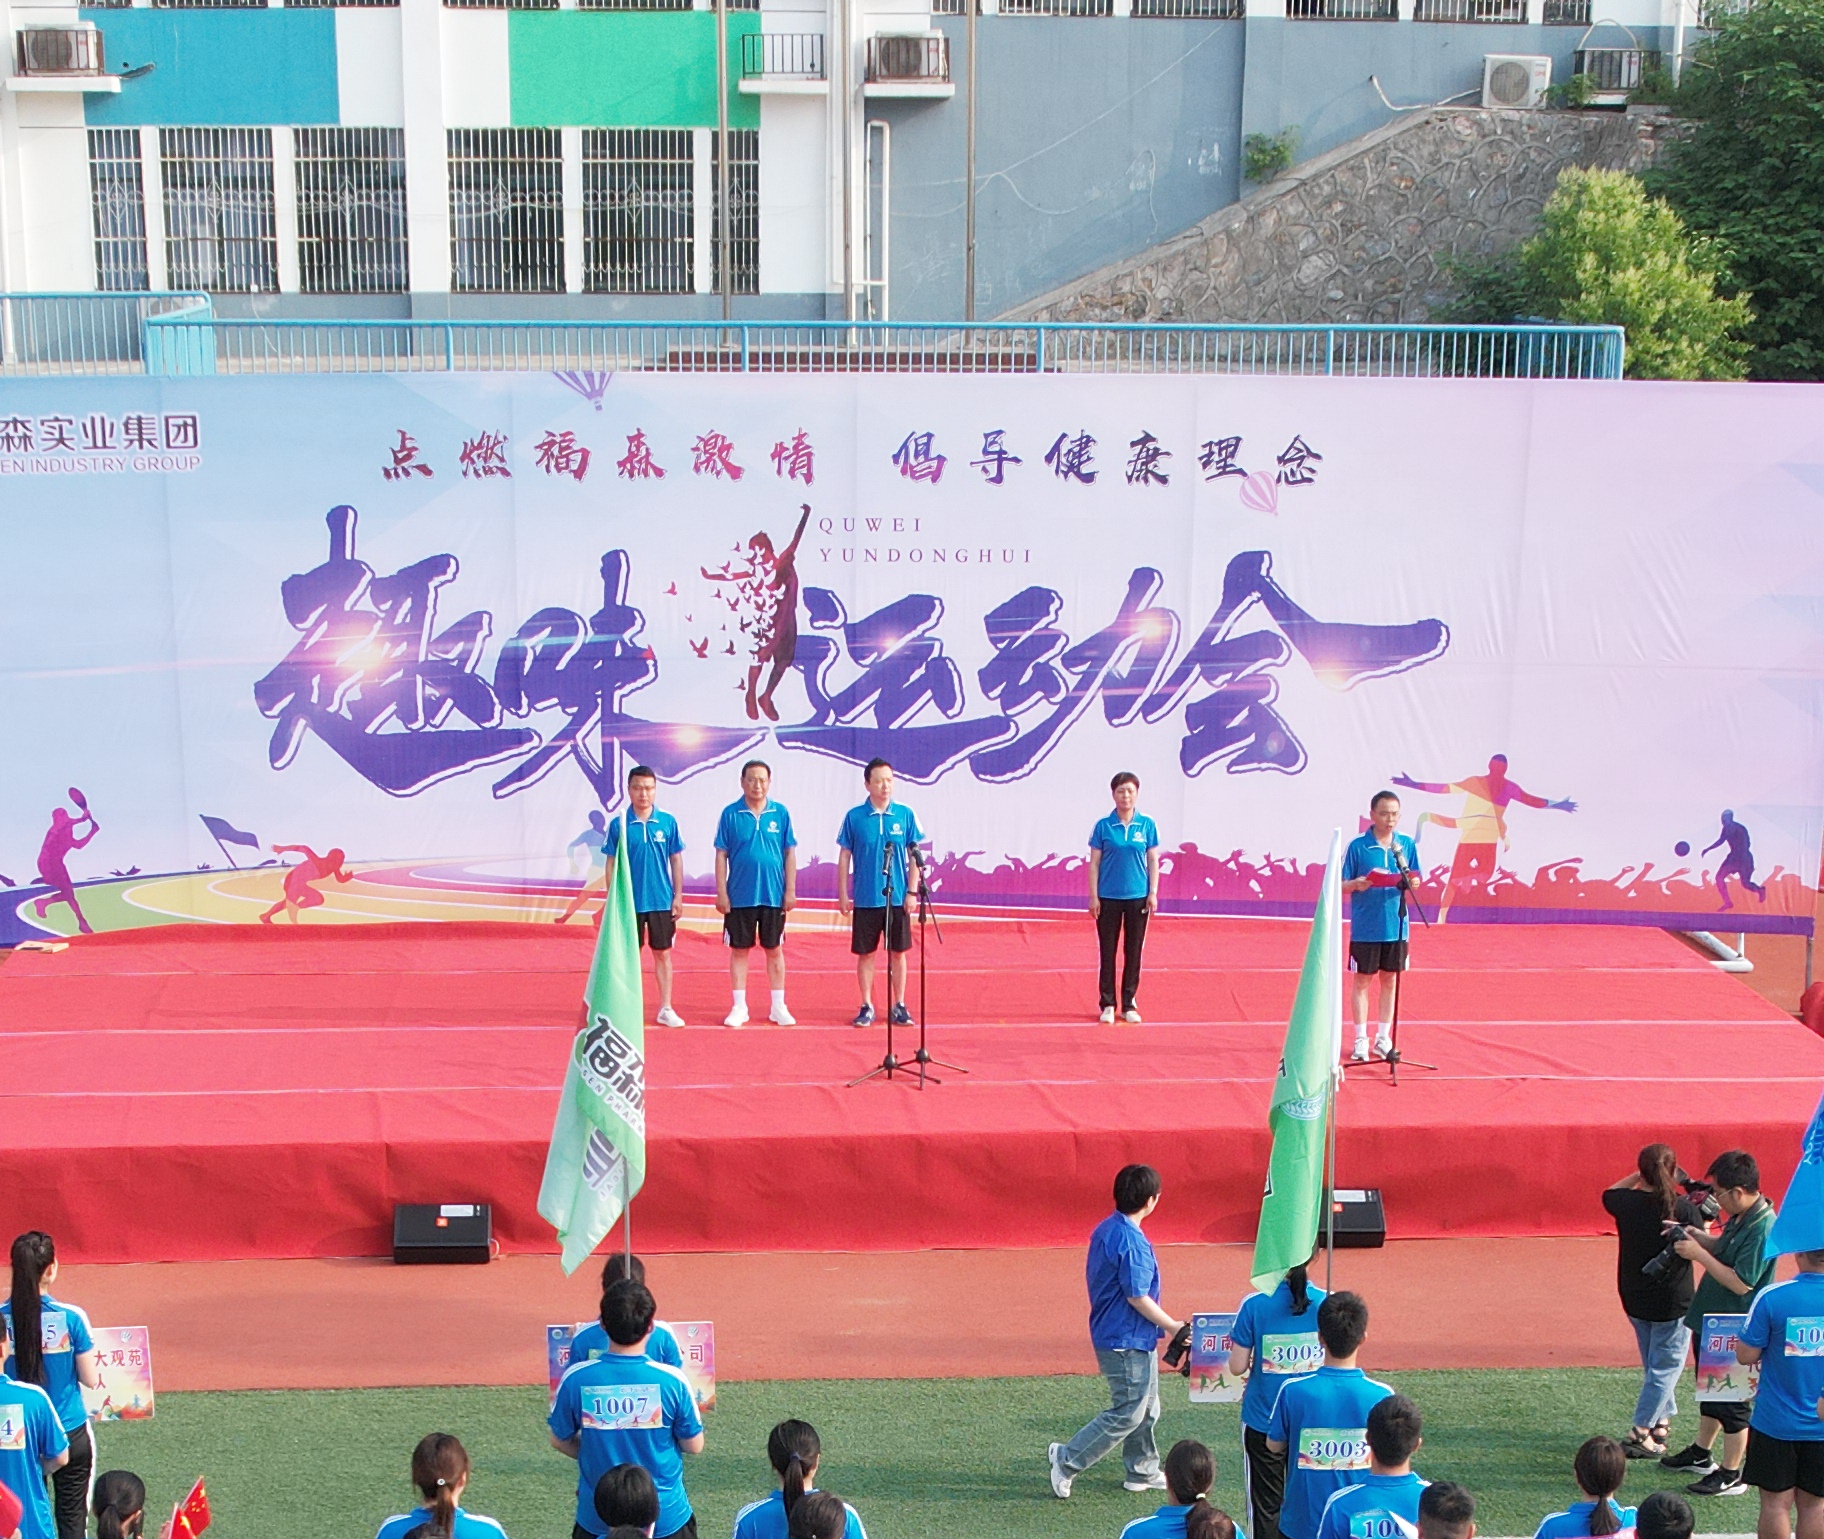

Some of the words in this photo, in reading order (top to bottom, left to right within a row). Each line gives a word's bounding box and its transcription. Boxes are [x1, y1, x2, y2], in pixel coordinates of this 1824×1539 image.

[30, 456, 126, 474] INDUSTRY
[132, 454, 202, 473] GROUP
[380, 428, 821, 486] 点燃福森激情
[891, 430, 1326, 486] 倡导健康理念
[817, 516, 923, 534] QUWEI
[818, 546, 1033, 566] YUNDONGHUI
[94, 1349, 143, 1368] 大观苑
[592, 1397, 649, 1416] 1007
[1308, 1439, 1368, 1458] 3003
[1363, 1517, 1404, 1538] 100
